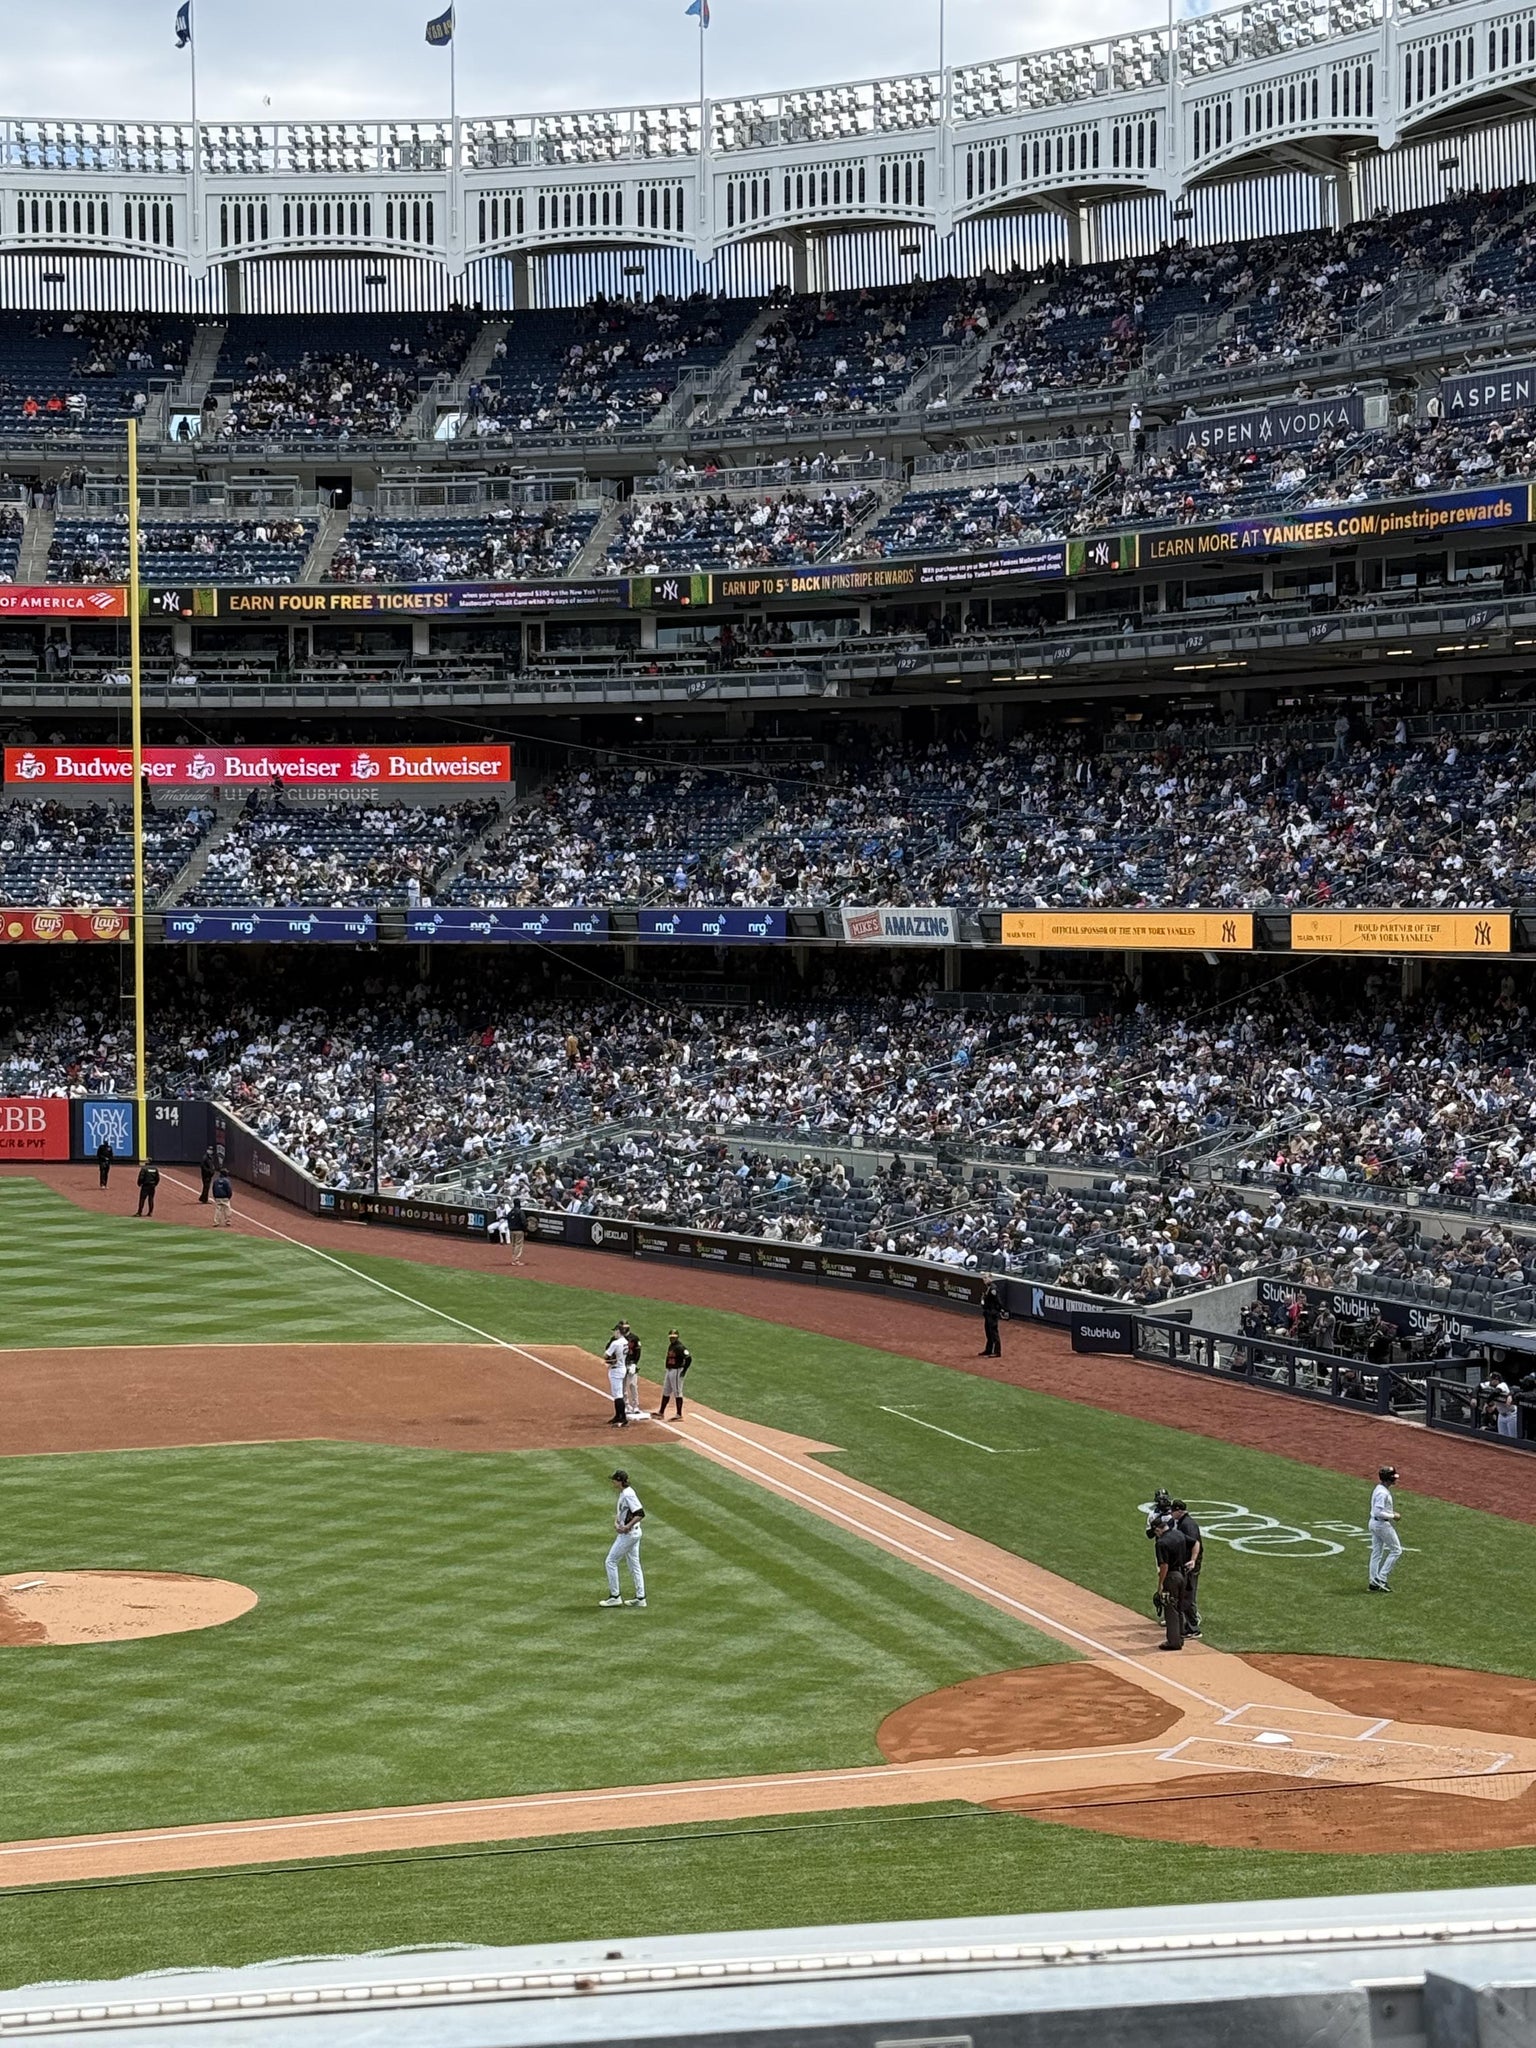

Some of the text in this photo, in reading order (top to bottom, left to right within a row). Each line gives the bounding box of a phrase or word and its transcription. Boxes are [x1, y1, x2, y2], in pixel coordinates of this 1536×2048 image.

[1451, 379, 1529, 410] ASPEN
[1186, 406, 1349, 450] ASPEN VODKA
[1150, 498, 1514, 560] LEARN MORE AT YANKEES.COM/pinstriperewards
[722, 581, 746, 597] EARN
[748, 580, 761, 595] UP
[762, 579, 774, 594] TO
[791, 576, 820, 593] BACK
[821, 575, 831, 589] IN
[831, 571, 873, 589] PINSTRIPE
[1, 597, 85, 609] OF AMERICA
[229, 596, 274, 610] EARN
[279, 595, 325, 610] FOUR
[330, 595, 373, 609] FREE
[55, 756, 176, 778] Budweser
[223, 756, 341, 778] Budweiser
[388, 756, 502, 777] Budweiser
[287, 788, 379, 800] CLUBHOUSE
[172, 921, 196, 935] nrg
[231, 921, 253, 935] nrg
[288, 921, 311, 935] nrg
[522, 921, 543, 935] nrg
[573, 921, 592, 935] nrg
[655, 921, 767, 936] nrg nrg nrg
[852, 916, 949, 937] MIKE'S AMAZING
[1051, 926, 1196, 936] OFFICIAL SPONSOR OF THE NEW YORK YANKEES
[1353, 923, 1441, 933] PROUD PARTNER OF THE
[1361, 933, 1434, 942] NEW YORK YANKEES
[0, 1107, 47, 1132] BB
[92, 1108, 125, 1122] NEW
[155, 1106, 179, 1120] 314
[86, 1121, 129, 1137] YORK
[17, 1139, 25, 1148] &
[26, 1139, 46, 1148] PVF
[1044, 1294, 1064, 1311] KEAN
[1408, 1309, 1460, 1336] Stuub
[1080, 1326, 1121, 1339] StubHub
